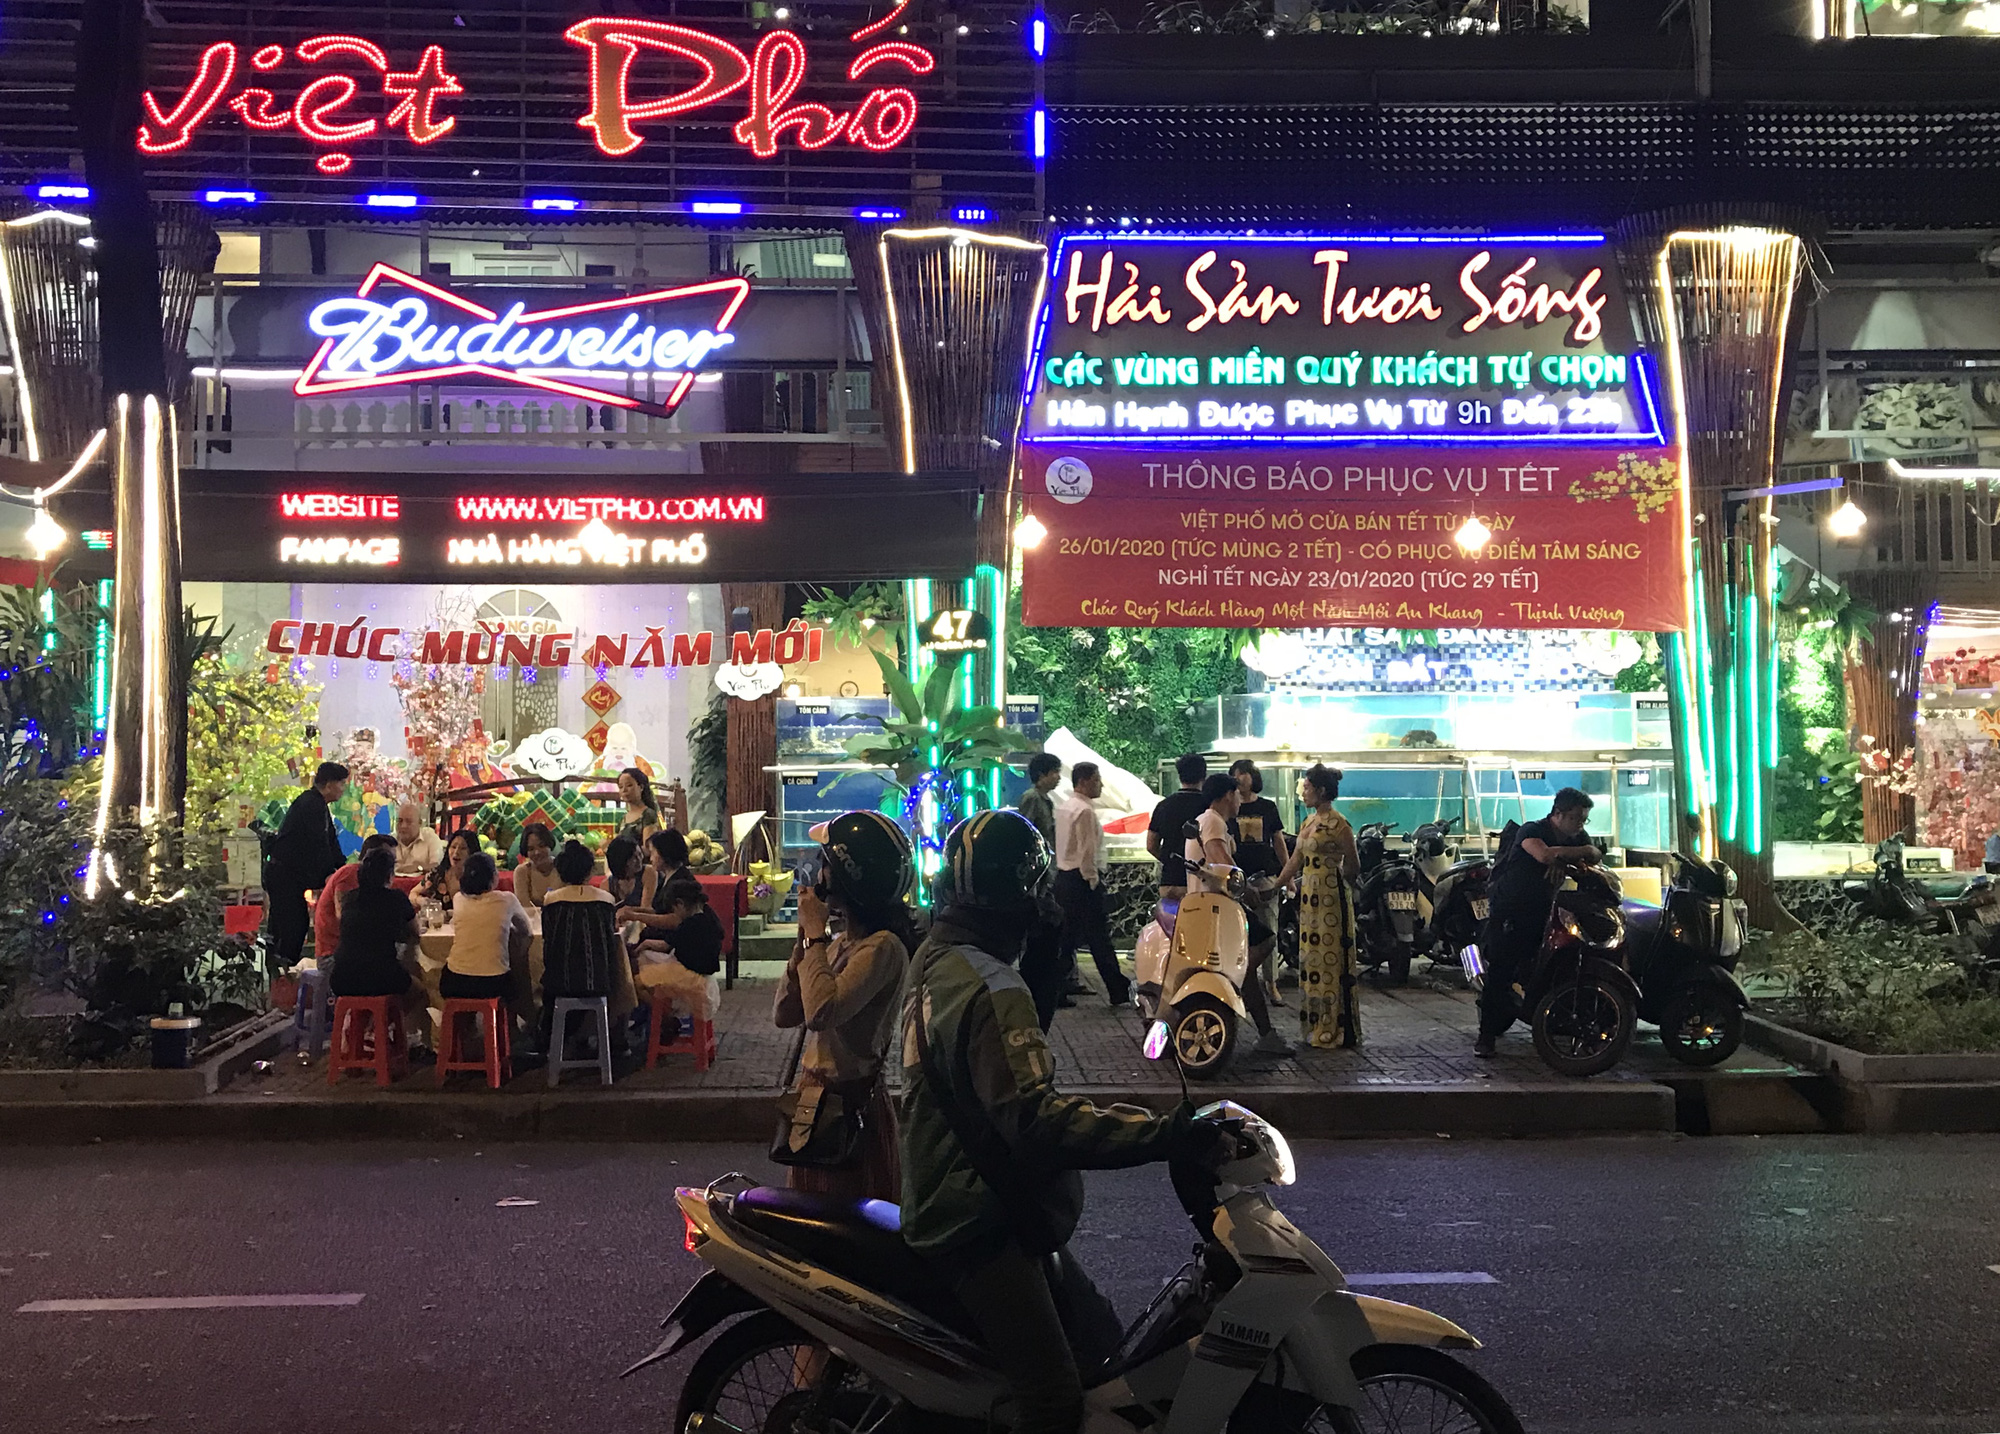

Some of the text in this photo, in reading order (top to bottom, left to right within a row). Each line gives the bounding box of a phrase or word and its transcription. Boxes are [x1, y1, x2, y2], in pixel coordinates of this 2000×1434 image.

[136, 0, 935, 174] Việt Phố
[1065, 250, 1607, 341] Hải Sản Tươi Sống
[307, 297, 735, 374] Budweiser
[1045, 347, 1627, 389] CÁC VÙNG MIỀN QUÝ KHÁCH TỰ CHỌN
[1114, 401, 1189, 432] Hạnh
[1198, 401, 1275, 431] Được
[1285, 400, 1358, 429] Phục
[1364, 399, 1402, 430] Vụ
[1407, 399, 1448, 426] Từ
[1457, 401, 1491, 425] 9h
[1142, 458, 1560, 496] THÔNG BÁO PHỤC VỤ TẾT
[281, 494, 398, 517] WEBSITE
[456, 497, 763, 520] WWW.VIETPHO.COM.VN
[1181, 509, 1219, 533] VIỆT
[1225, 508, 1265, 530] PHỐ
[1271, 509, 1304, 530] MỞ
[1309, 508, 1349, 530] CỬA
[1355, 511, 1391, 531] BÁN
[1397, 509, 1428, 531] TẾT
[1434, 511, 1457, 531] TỪ
[281, 537, 399, 563] FANPAGE
[447, 533, 503, 563] NHÀ
[508, 533, 582, 564] HÀNG
[652, 533, 707, 564] PHỐ
[1060, 538, 1164, 556] 26/01/2020
[1171, 538, 1217, 561] (TỨC
[1223, 537, 1283, 558] MÙNG
[1288, 542, 1299, 558] 2
[1303, 536, 1342, 563] TẾT)
[1360, 541, 1392, 559] CÓ
[1398, 543, 1452, 565] PHỤC
[1487, 537, 1536, 560] ĐIỂM
[1541, 542, 1579, 560] TÂM
[1586, 541, 1642, 560] SÁNG
[1158, 564, 1539, 593] NGHỈ TẾT NGÀY 23/01/2020 (TỨC 29 TẾT)
[932, 610, 972, 640] 47
[1081, 599, 1118, 617] Chúc
[1125, 600, 1161, 624] Quý
[1166, 599, 1215, 617] Khách
[1220, 600, 1265, 626] Hàng
[1272, 600, 1305, 620] Một
[1358, 602, 1390, 619] Mới
[1395, 601, 1422, 620] An
[1429, 602, 1483, 628] Khang
[1510, 601, 1563, 622] Thịnh
[1568, 602, 1625, 628] Vượng
[266, 615, 400, 662] CHÚC
[420, 619, 573, 668] MỪNG
[592, 625, 713, 669] NĂM
[732, 617, 824, 667] MỚI
[1008, 1027, 1046, 1047] Gra
[1221, 1320, 1270, 1346] YAMAHA
